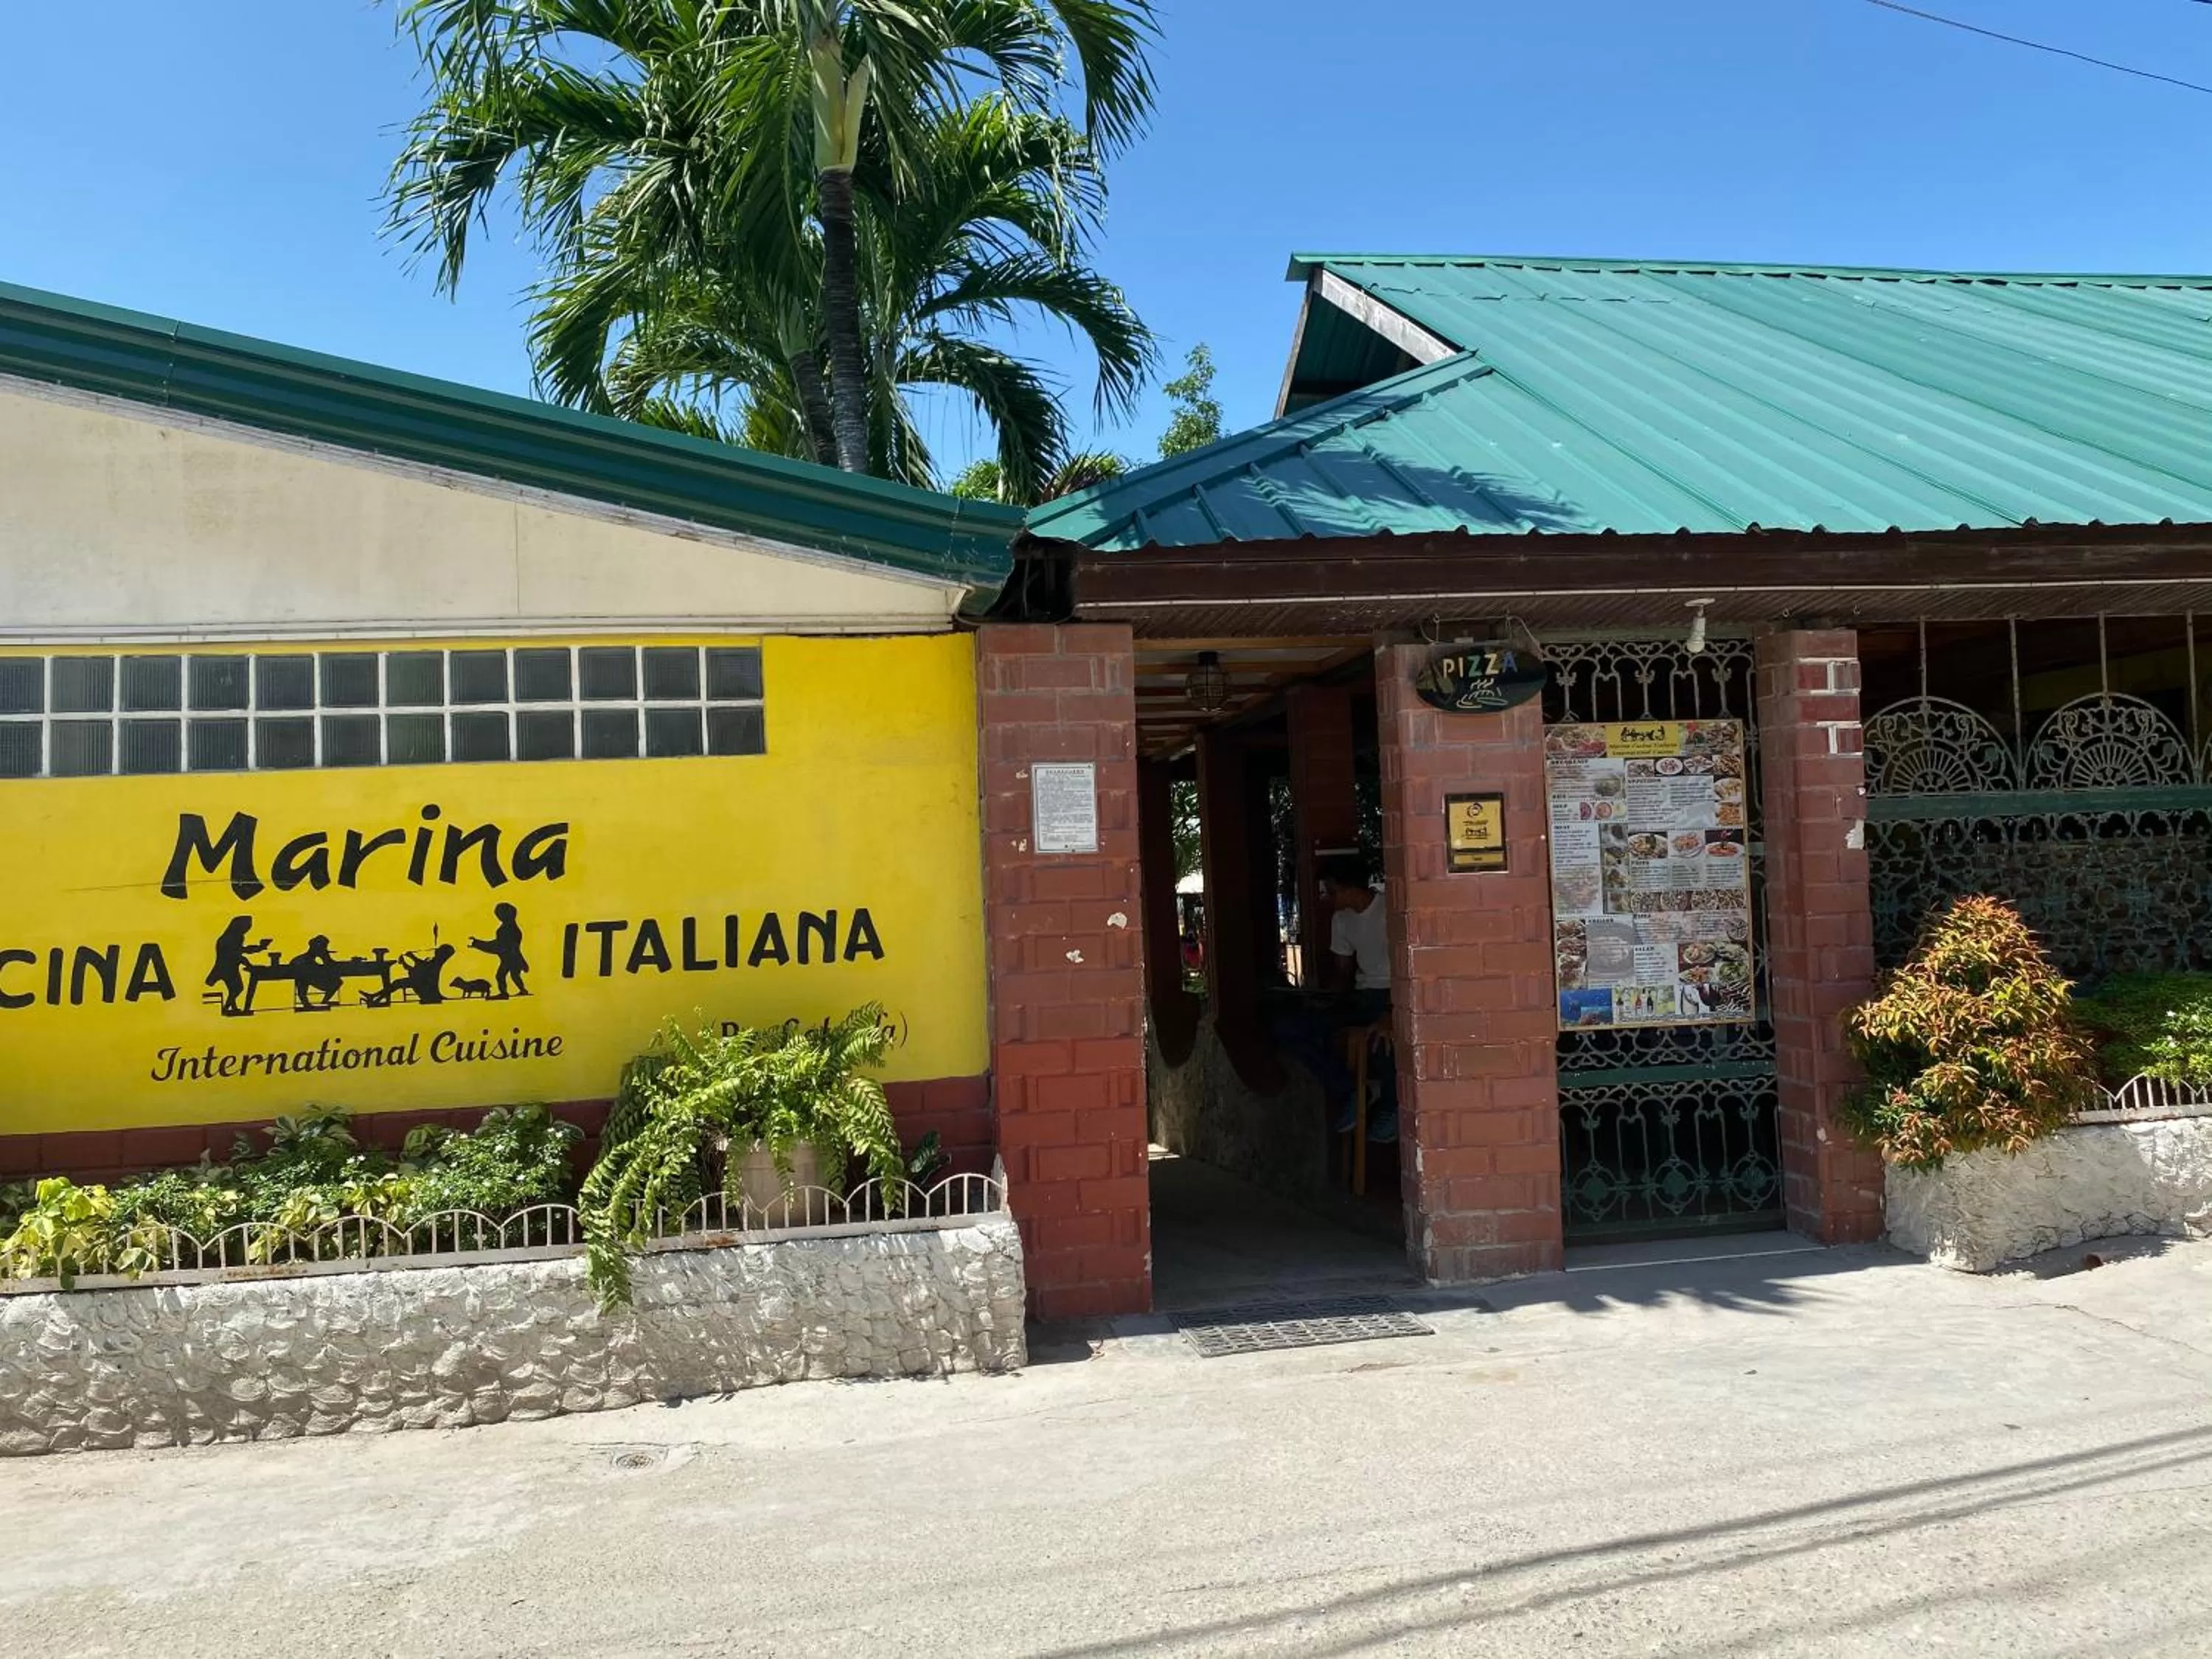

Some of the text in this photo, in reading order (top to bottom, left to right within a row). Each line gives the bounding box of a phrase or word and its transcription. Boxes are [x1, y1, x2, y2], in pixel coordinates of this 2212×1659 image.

[1441, 651, 1518, 679] PIZZA
[161, 804, 568, 901] Marina
[0, 908, 886, 1009] CINA ITALIANA
[151, 1027, 563, 1082] International Cuisine
